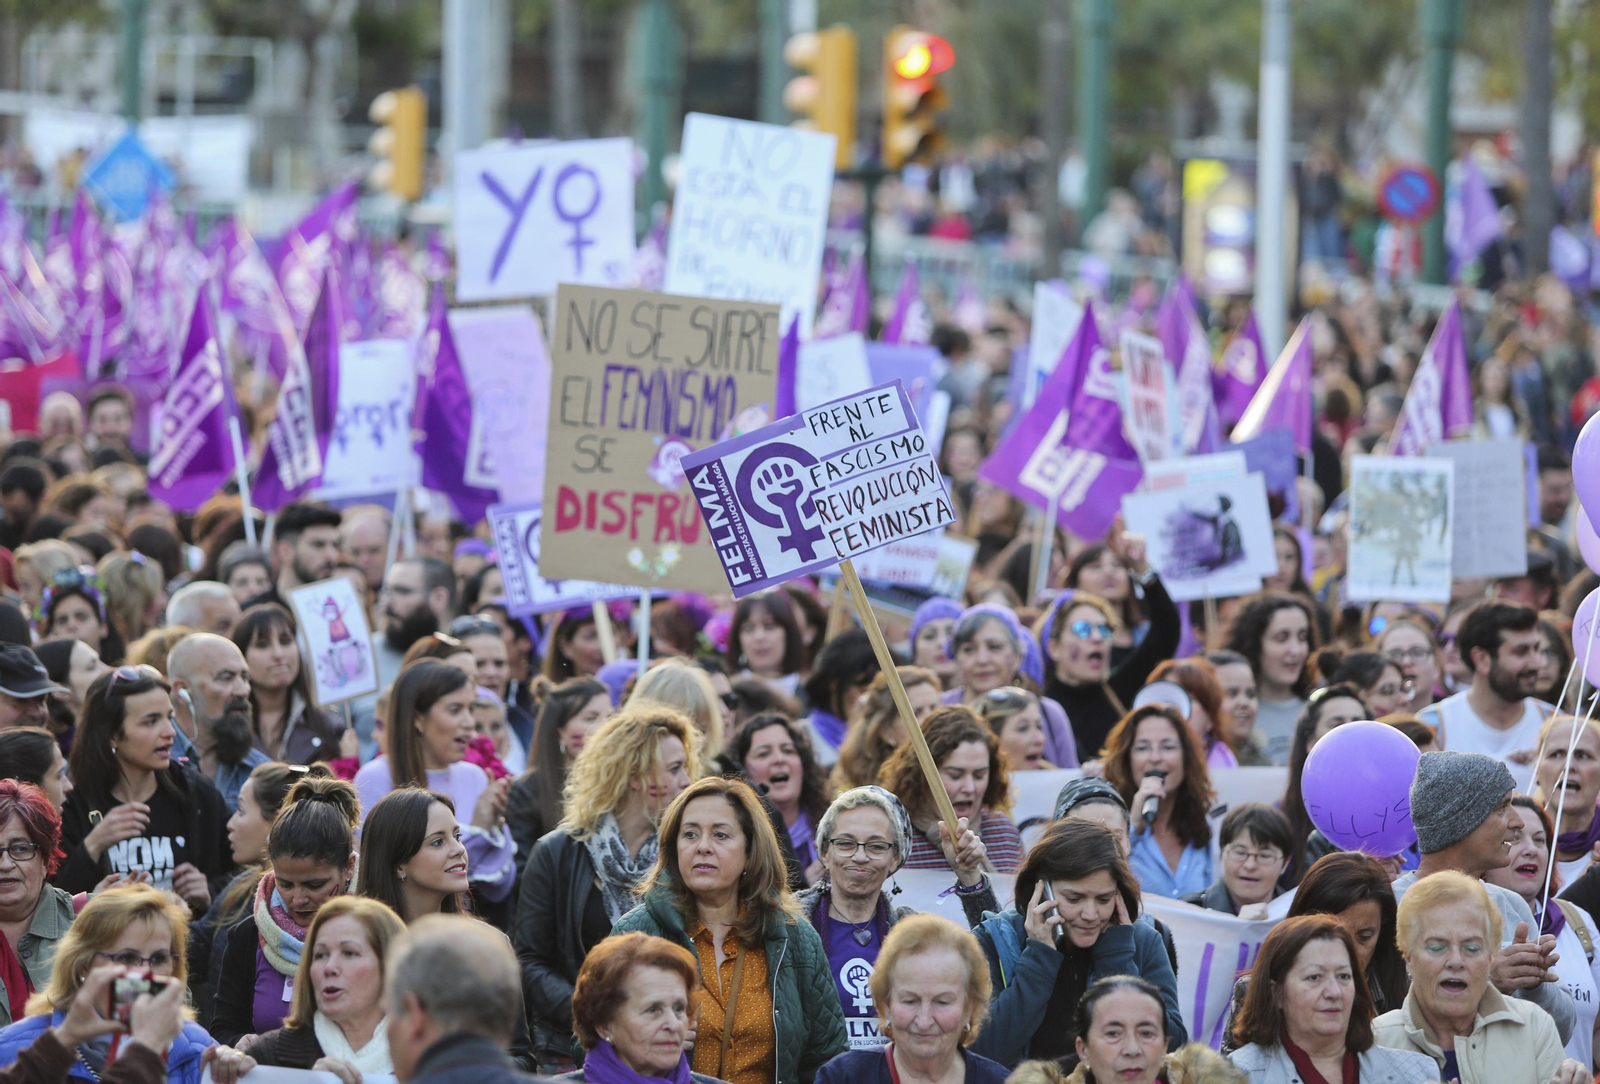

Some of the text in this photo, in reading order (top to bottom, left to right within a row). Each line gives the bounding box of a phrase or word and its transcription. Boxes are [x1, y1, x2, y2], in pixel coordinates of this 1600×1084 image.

[721, 122, 803, 180] NO
[679, 203, 813, 269] HORNO
[565, 298, 618, 356] NO
[626, 300, 682, 364] SE
[684, 305, 780, 376] SUFRE
[560, 374, 597, 428] EL
[808, 393, 893, 438] FRENTE
[571, 434, 617, 474] SE
[808, 434, 925, 488] FASCISMO
[850, 423, 874, 443] AL
[554, 484, 704, 546] DISFRU
[711, 461, 763, 579] FEMINISTAS EN LUCHA MÁLAGA
[814, 461, 936, 525] REVOLUCIÓN
[692, 465, 752, 586] FELMA
[827, 497, 953, 557] FEMINISTA
[1303, 797, 1411, 839] ELLYS
[849, 1021, 884, 1037] LM
